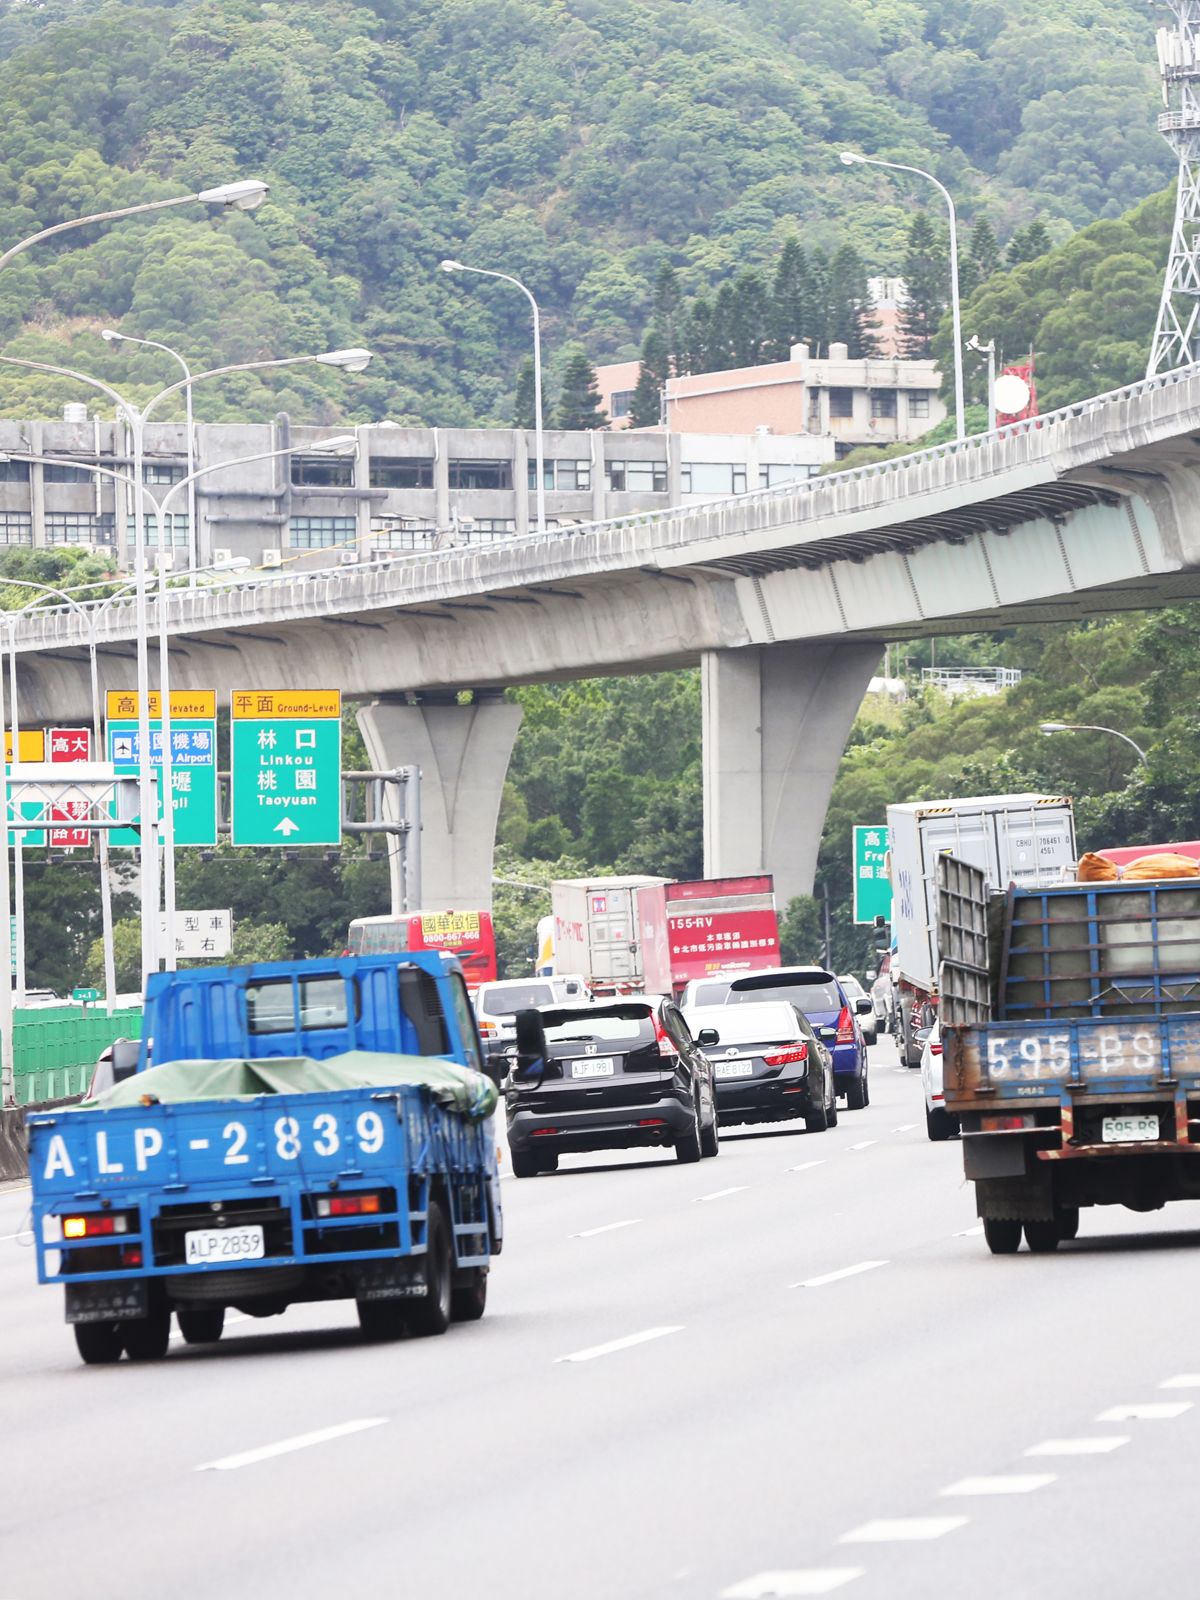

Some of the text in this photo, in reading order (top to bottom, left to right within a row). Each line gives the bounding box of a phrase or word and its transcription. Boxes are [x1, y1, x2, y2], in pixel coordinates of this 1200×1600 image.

[170, 704, 205, 713] levated
[236, 695, 274, 713] 平面
[277, 703, 337, 713] Ground-Level
[257, 729, 316, 750] 林口
[176, 753, 212, 765] Airport
[260, 754, 313, 766] Linkou
[257, 769, 317, 791] 桃園
[256, 794, 317, 808] Taoyuan
[864, 850, 884, 861] Fre
[670, 917, 713, 929] 155-RV
[986, 1033, 1156, 1079] 595-BS
[43, 1110, 386, 1180] ALP-2839
